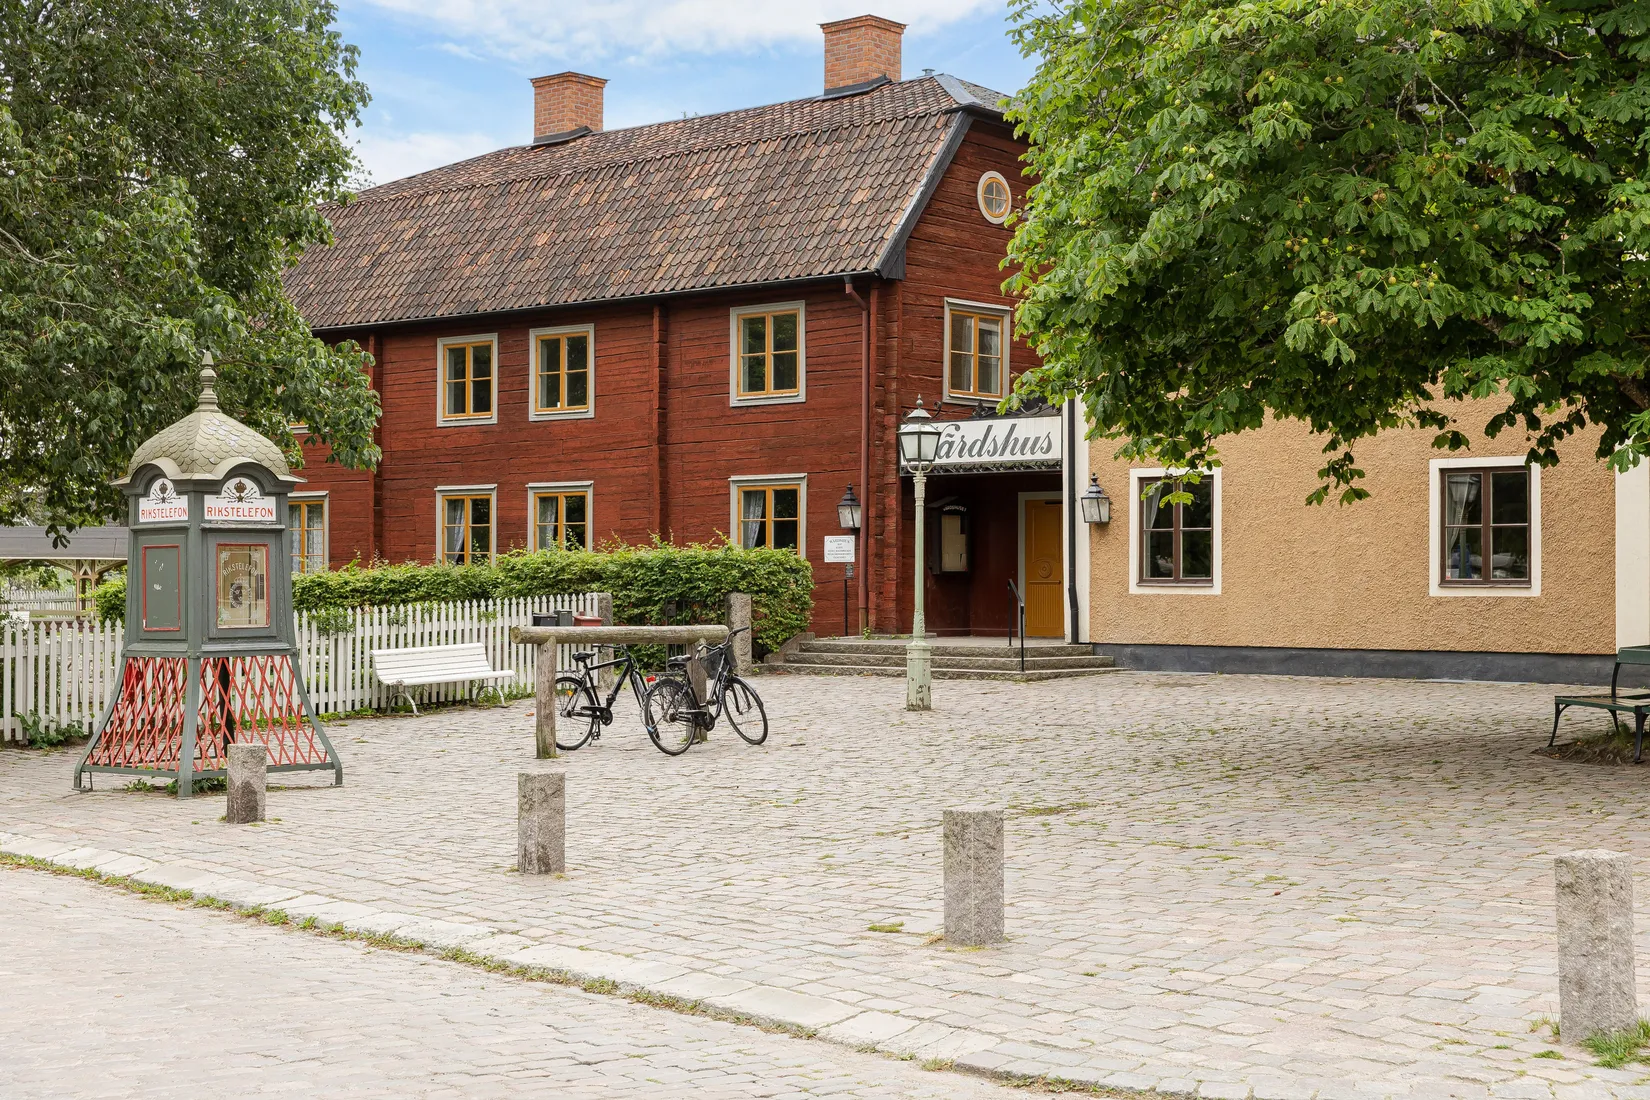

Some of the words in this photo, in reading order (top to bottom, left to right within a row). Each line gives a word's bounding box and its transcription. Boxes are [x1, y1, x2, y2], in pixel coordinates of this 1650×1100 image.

[140, 507, 188, 520] RIKSTELEFON
[206, 506, 274, 518] RIKSTELEFON
[222, 562, 259, 577] RIKSTELEFON
